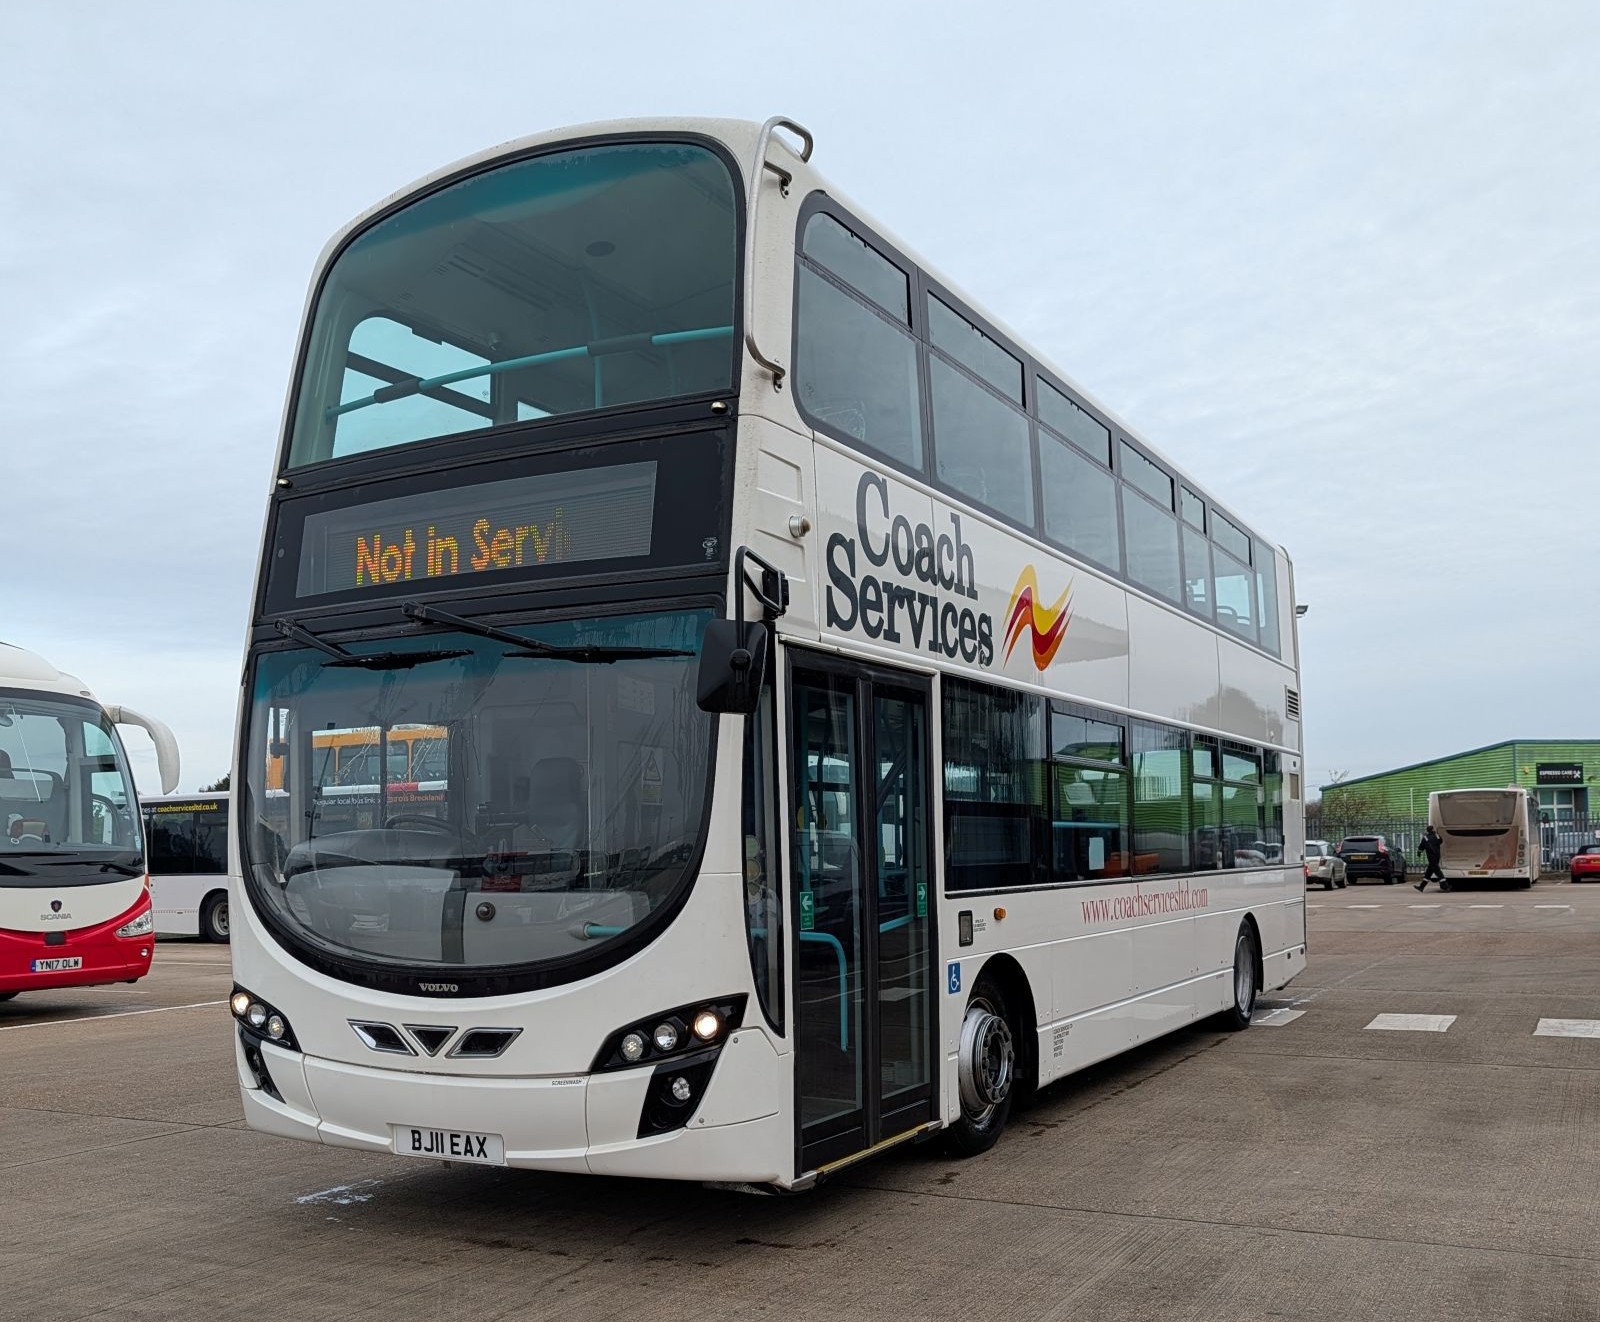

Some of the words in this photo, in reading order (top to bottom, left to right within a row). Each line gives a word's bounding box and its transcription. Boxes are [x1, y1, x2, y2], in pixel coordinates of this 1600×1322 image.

[356, 529, 416, 586] Not
[427, 526, 459, 576] in
[471, 507, 573, 571] Servi
[856, 471, 978, 601] Coach
[826, 532, 994, 667] Services
[40, 913, 72, 921] SCANIA
[1081, 880, 1208, 925] www.coachservicesltd.com
[40, 960, 60, 970] YN17
[62, 958, 79, 968] OLW
[419, 982, 459, 992] VOLVO
[411, 1129, 444, 1154] BJ11
[450, 1133, 488, 1159] EAX
